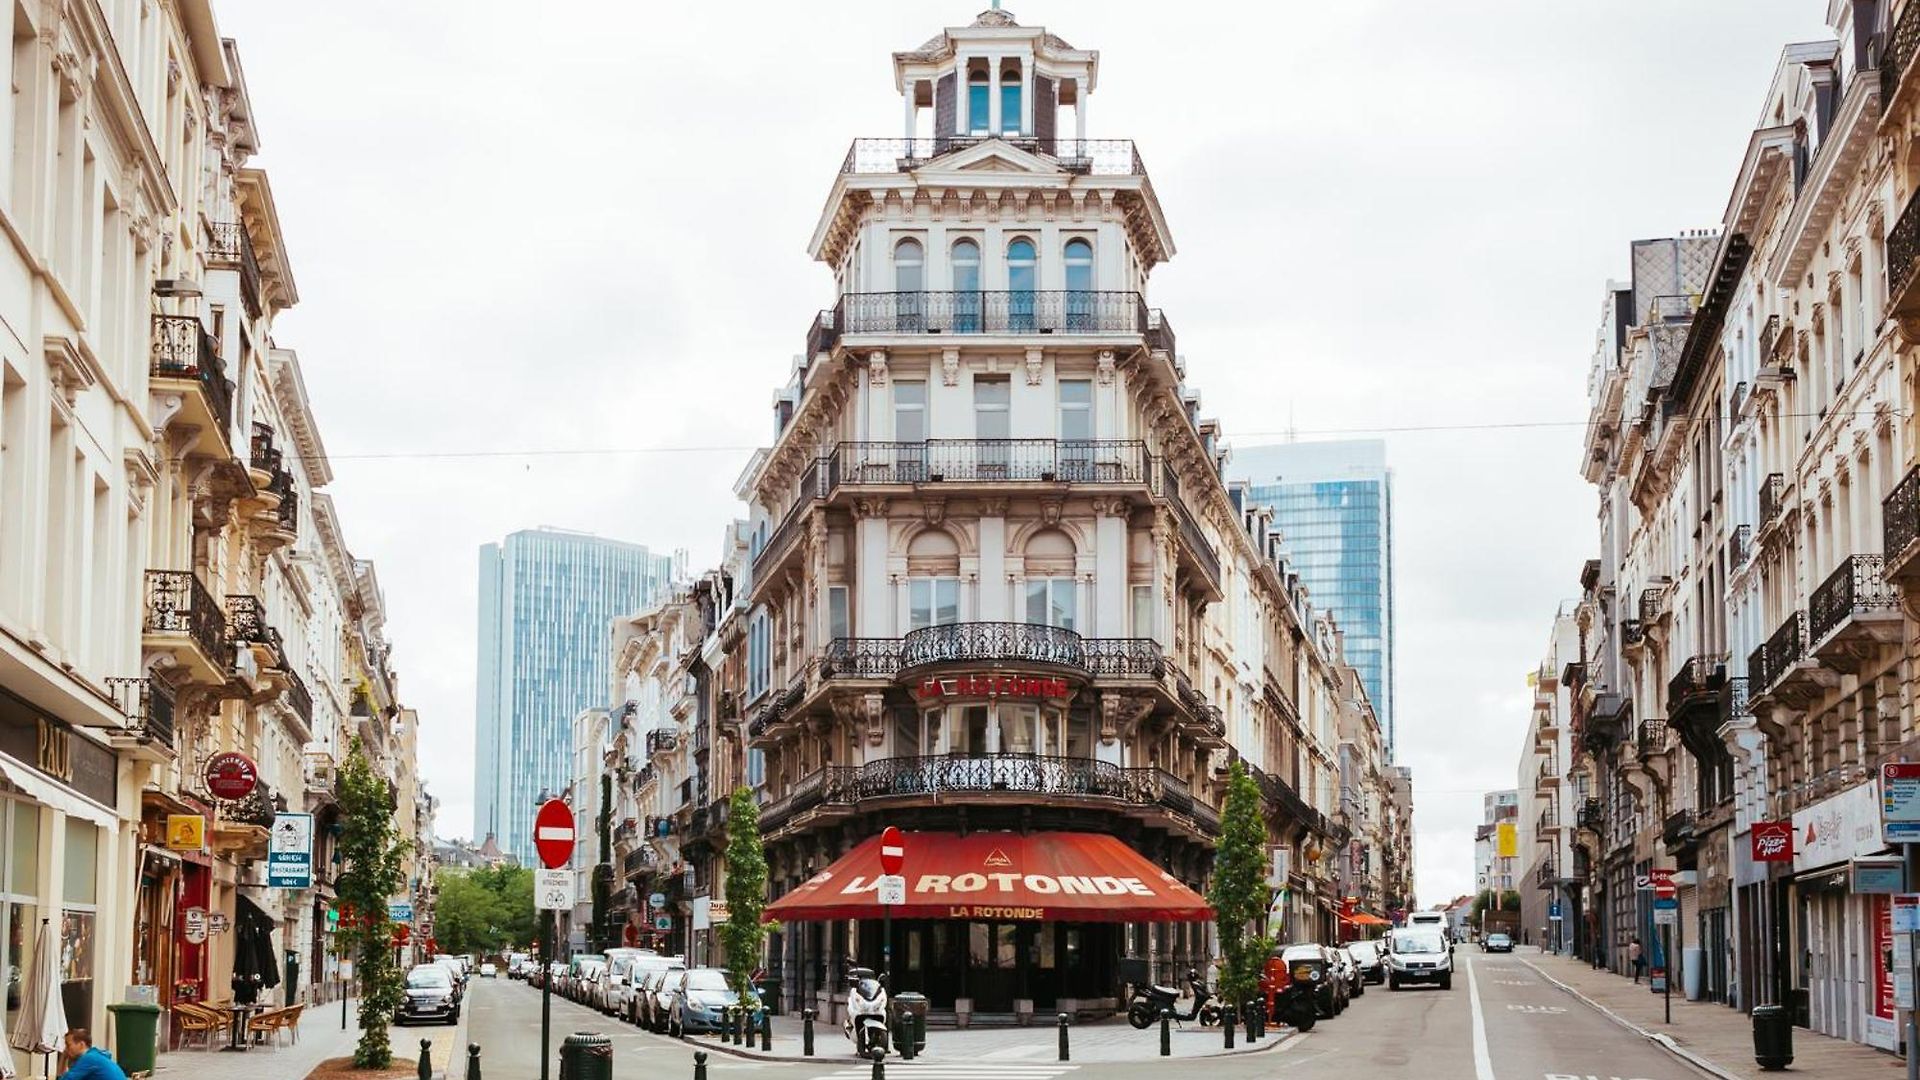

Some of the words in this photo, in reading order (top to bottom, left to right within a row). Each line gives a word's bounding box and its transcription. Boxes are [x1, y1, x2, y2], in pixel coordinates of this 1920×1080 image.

[916, 677, 942, 697] LA
[957, 675, 1069, 697] ROTONDE
[38, 718, 73, 782] PAUL
[1757, 836, 1787, 851] Pizza
[1762, 845, 1786, 857] Hut
[914, 872, 1156, 897] ROTONDE
[950, 907, 969, 917] LA
[973, 906, 1044, 919] ROTONDE
